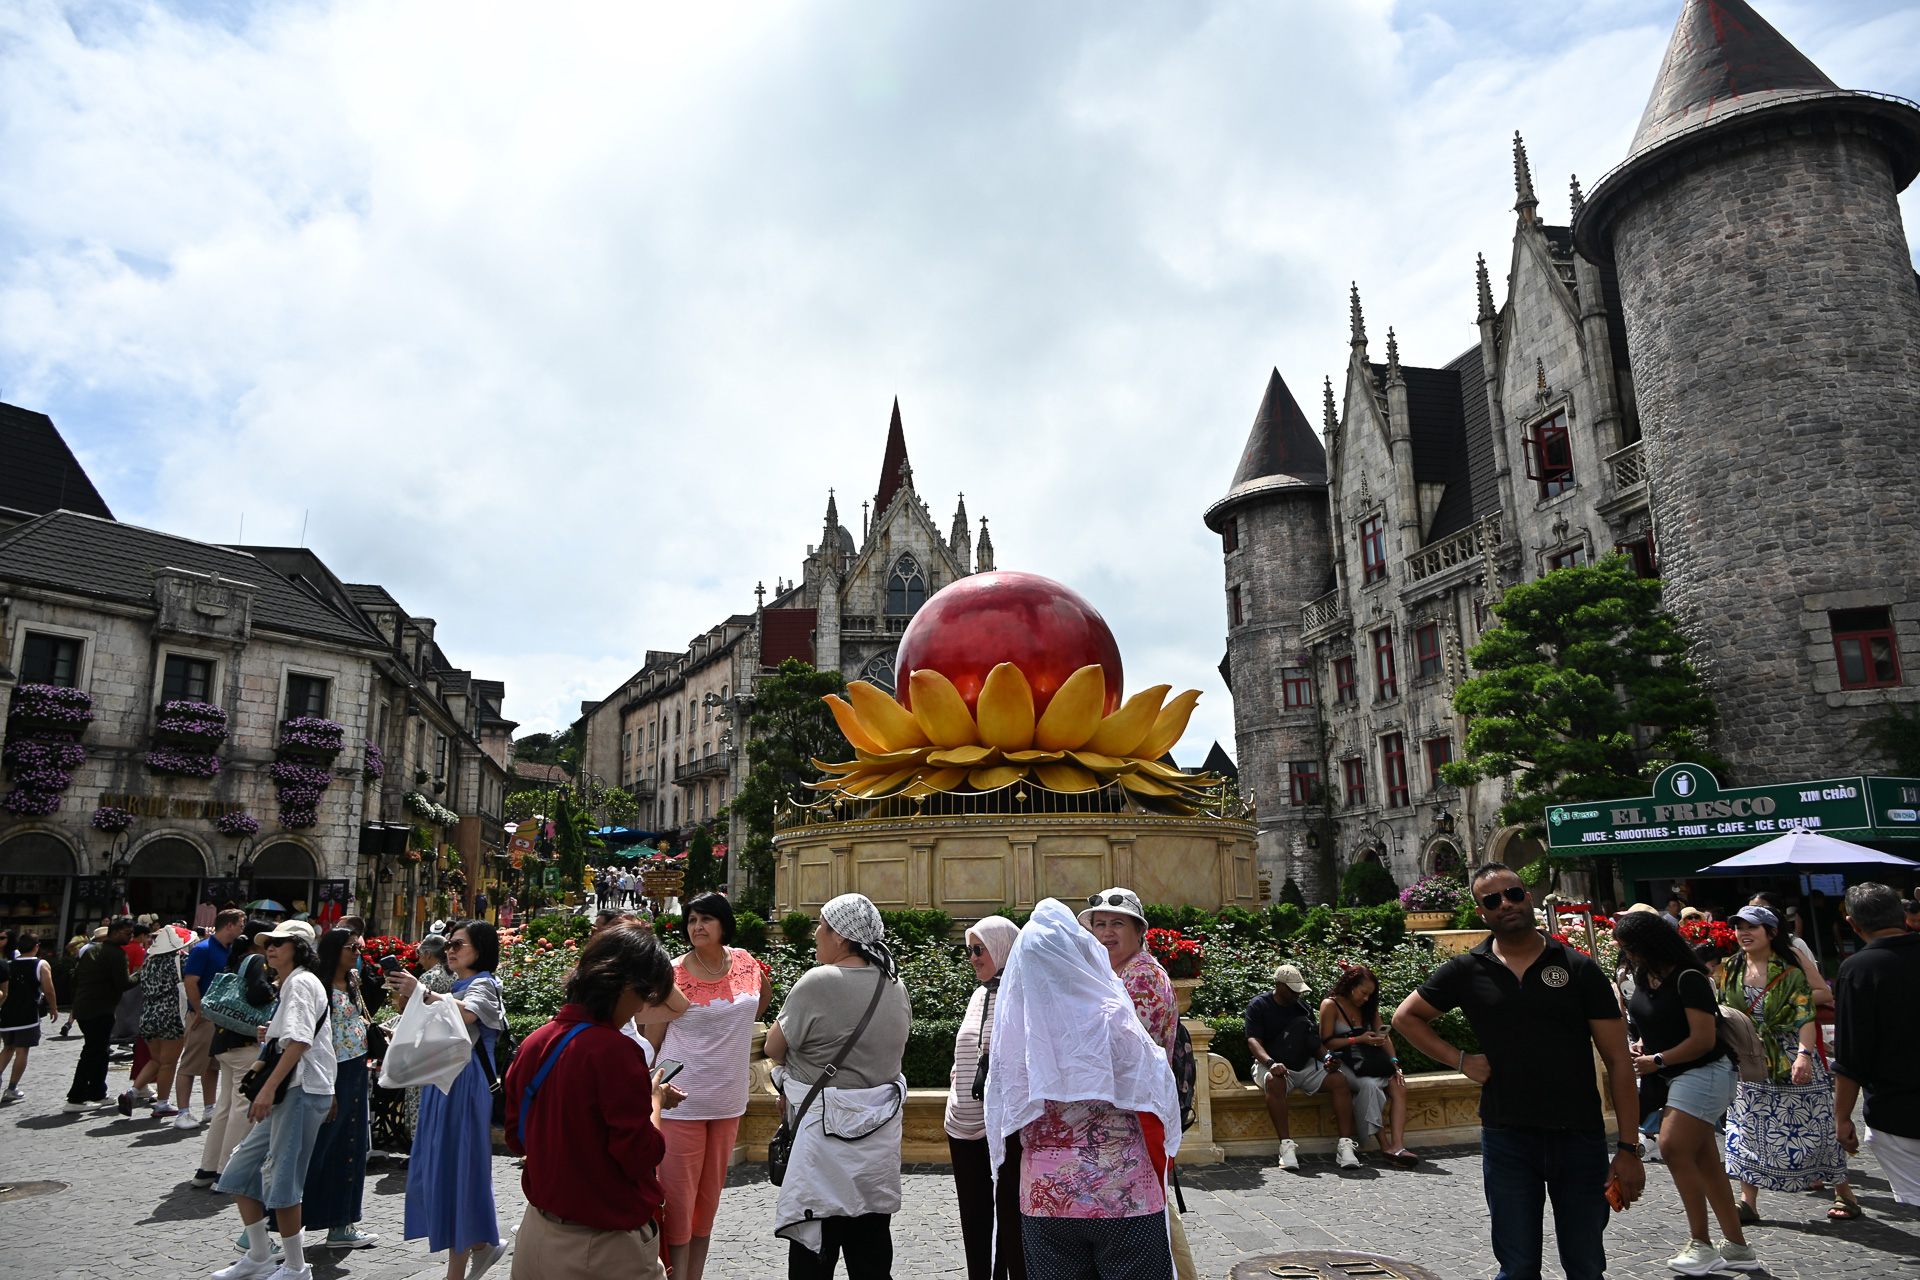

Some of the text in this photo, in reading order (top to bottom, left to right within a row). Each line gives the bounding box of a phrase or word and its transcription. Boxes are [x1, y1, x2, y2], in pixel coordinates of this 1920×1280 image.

[1799, 784, 1857, 802] XIN CHÀO
[1610, 797, 1776, 825] EL FRESCO
[1581, 816, 1821, 842] JUICE SMOOTHIES FRUIT CAFE ICE CREAM
[206, 1002, 263, 1026] SWITZERLAN
